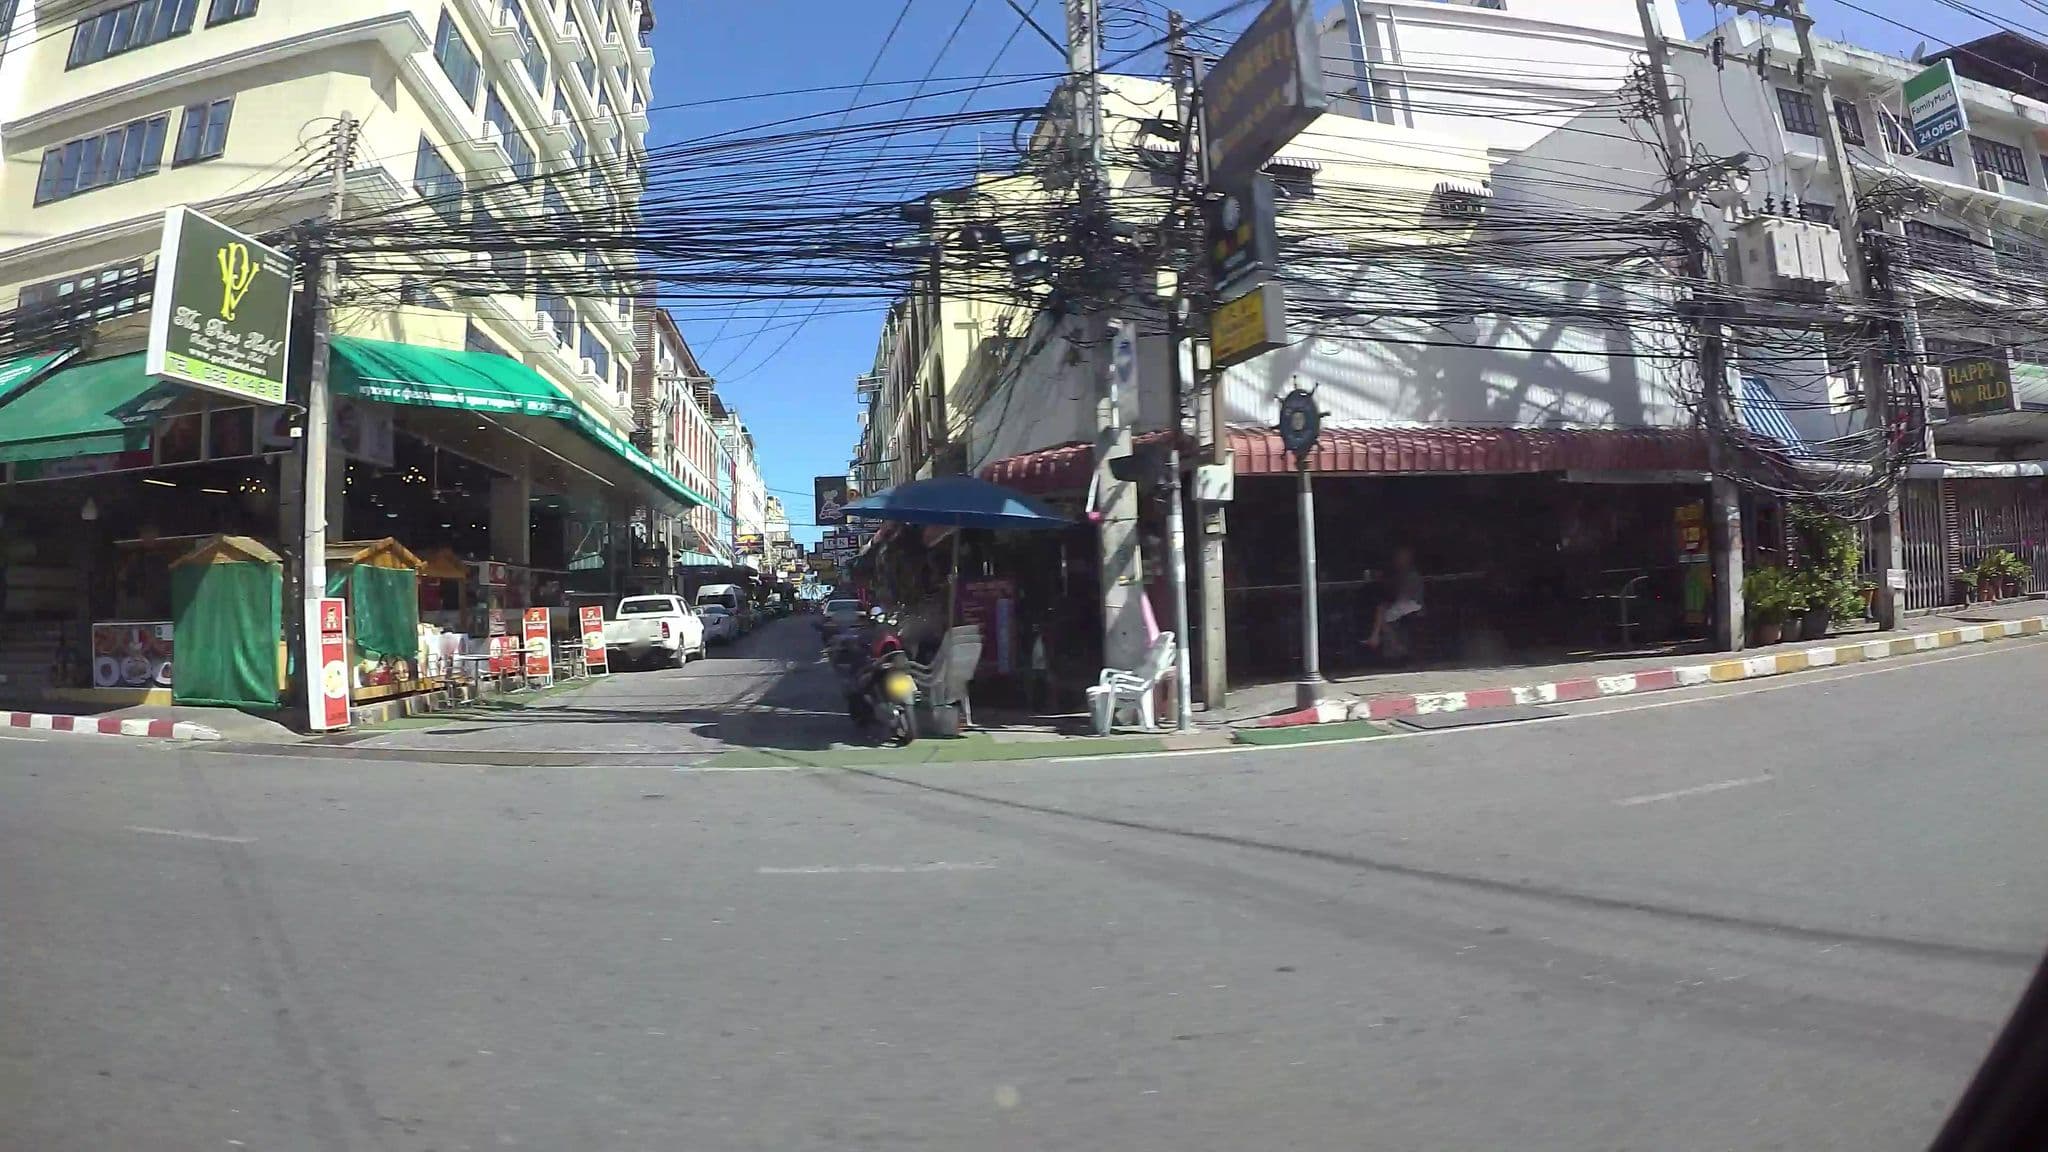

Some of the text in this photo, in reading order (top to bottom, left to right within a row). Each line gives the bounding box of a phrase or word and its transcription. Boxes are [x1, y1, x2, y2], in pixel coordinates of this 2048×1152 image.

[1911, 90, 1952, 115] FamilyMart
[1919, 117, 1959, 144] 24 OPEN
[1948, 361, 1995, 385] HAPPY
